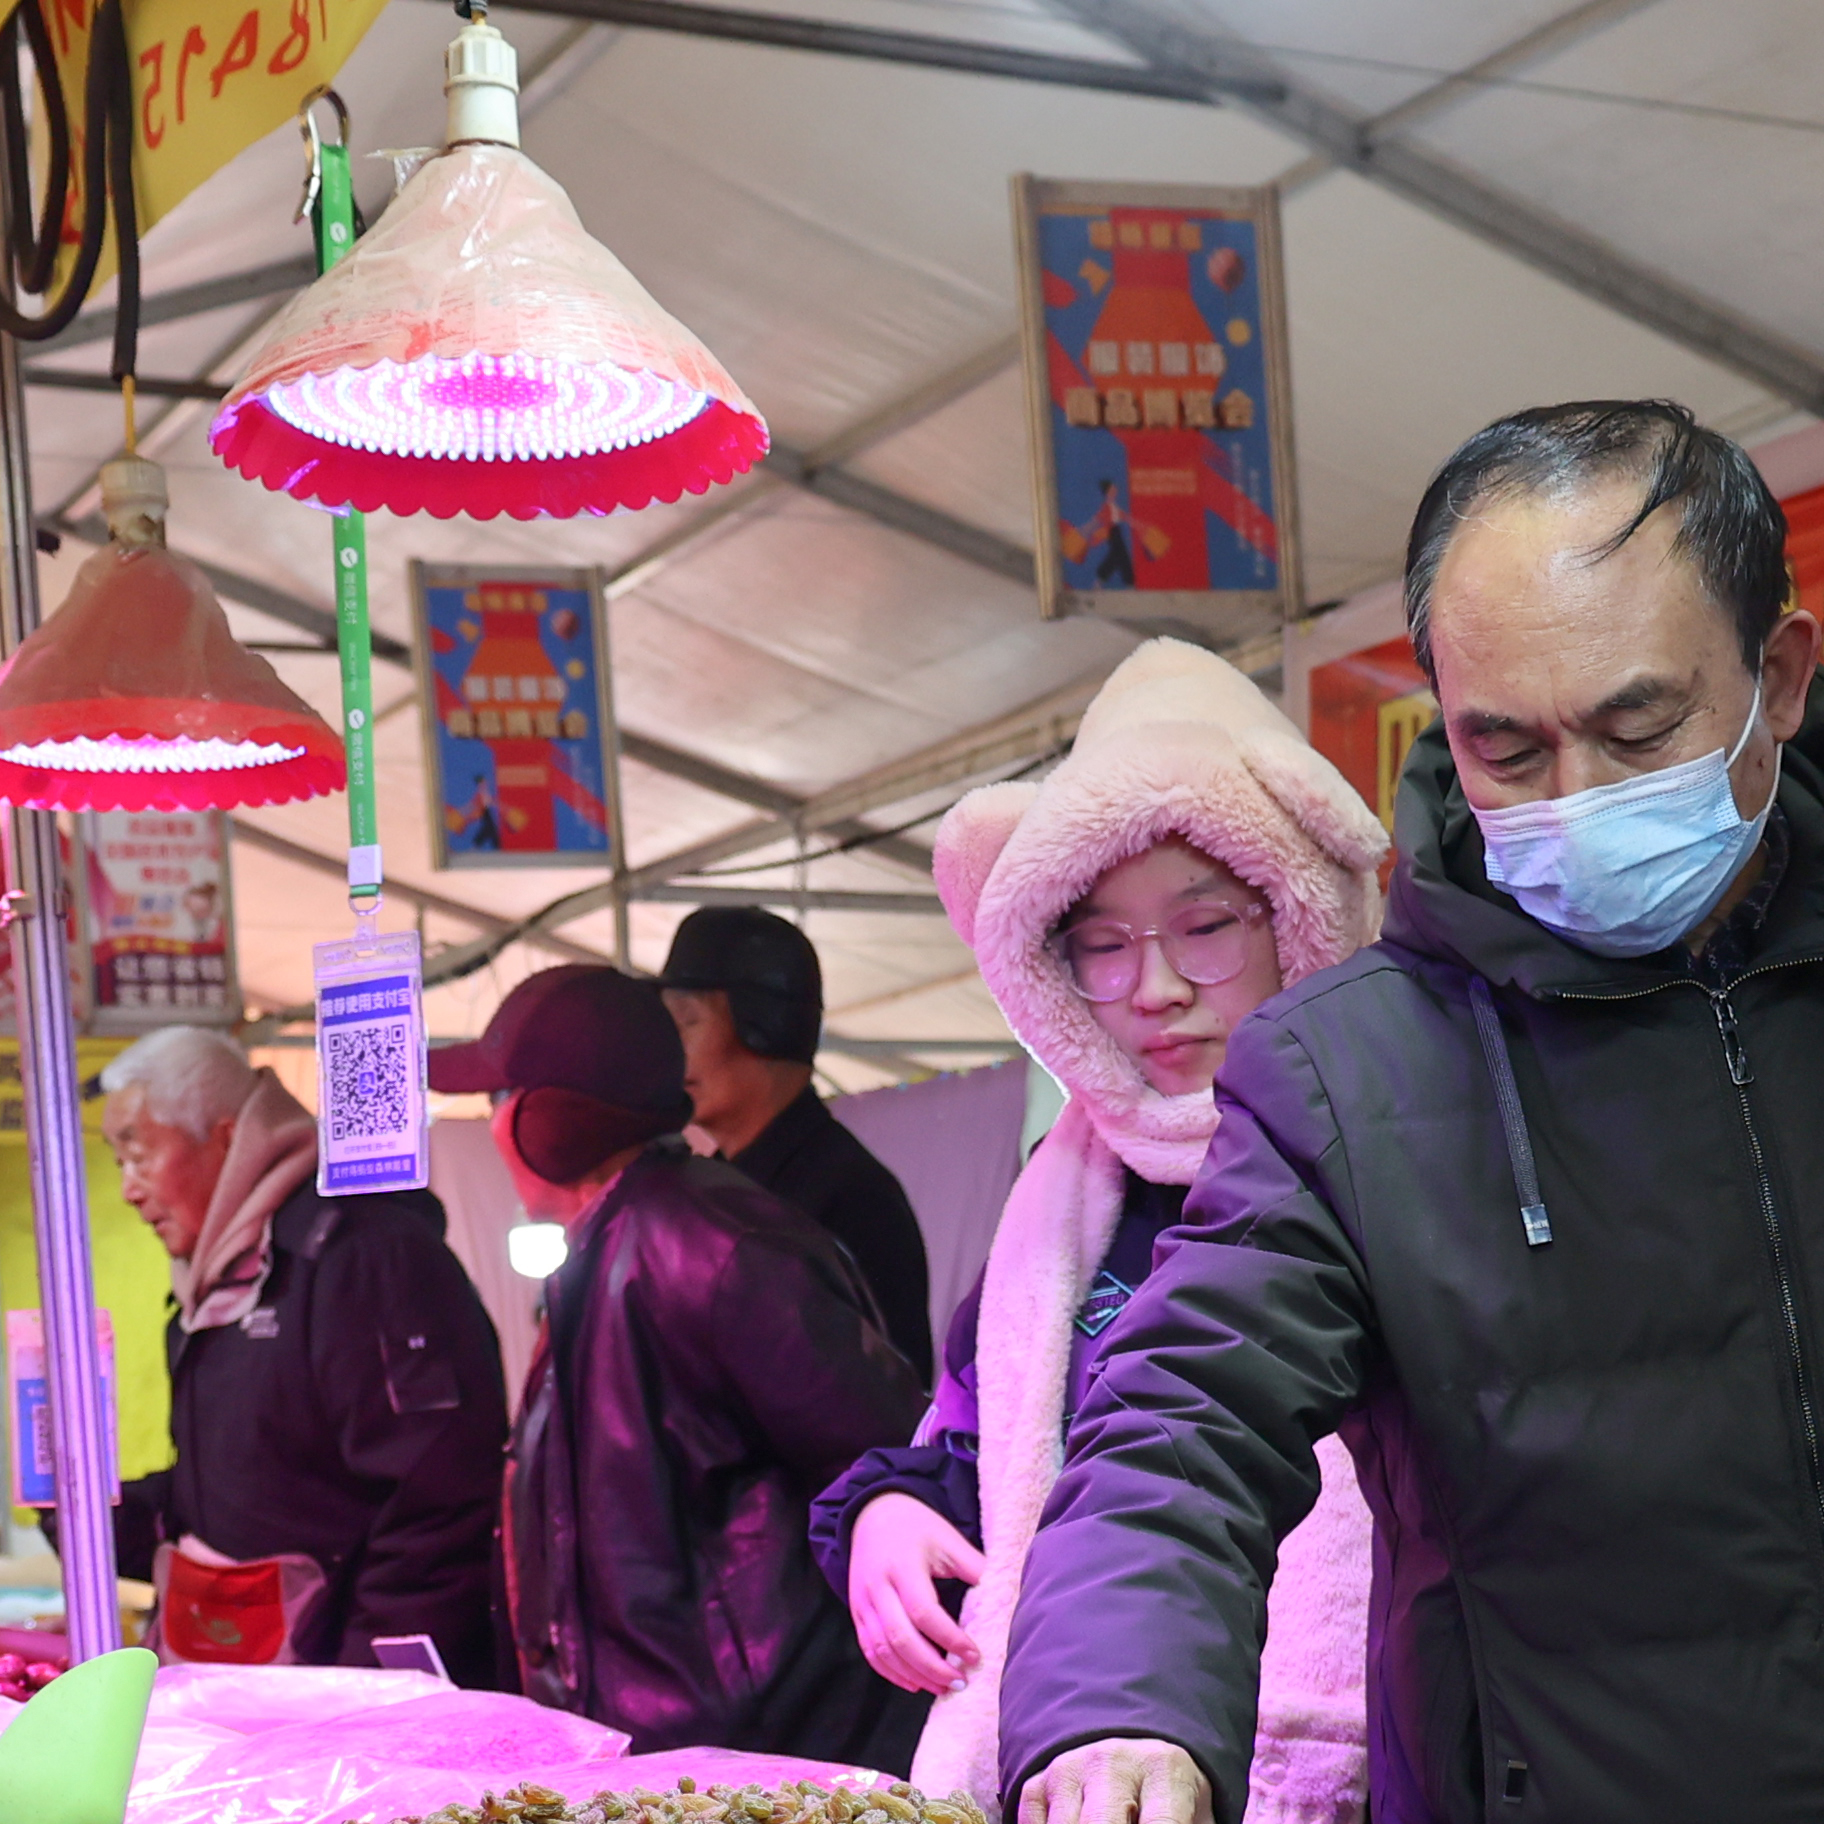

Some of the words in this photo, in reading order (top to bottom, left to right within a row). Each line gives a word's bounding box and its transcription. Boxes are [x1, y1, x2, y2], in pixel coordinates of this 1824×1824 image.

[322, 988, 411, 1020] 推荐使用支付宝
